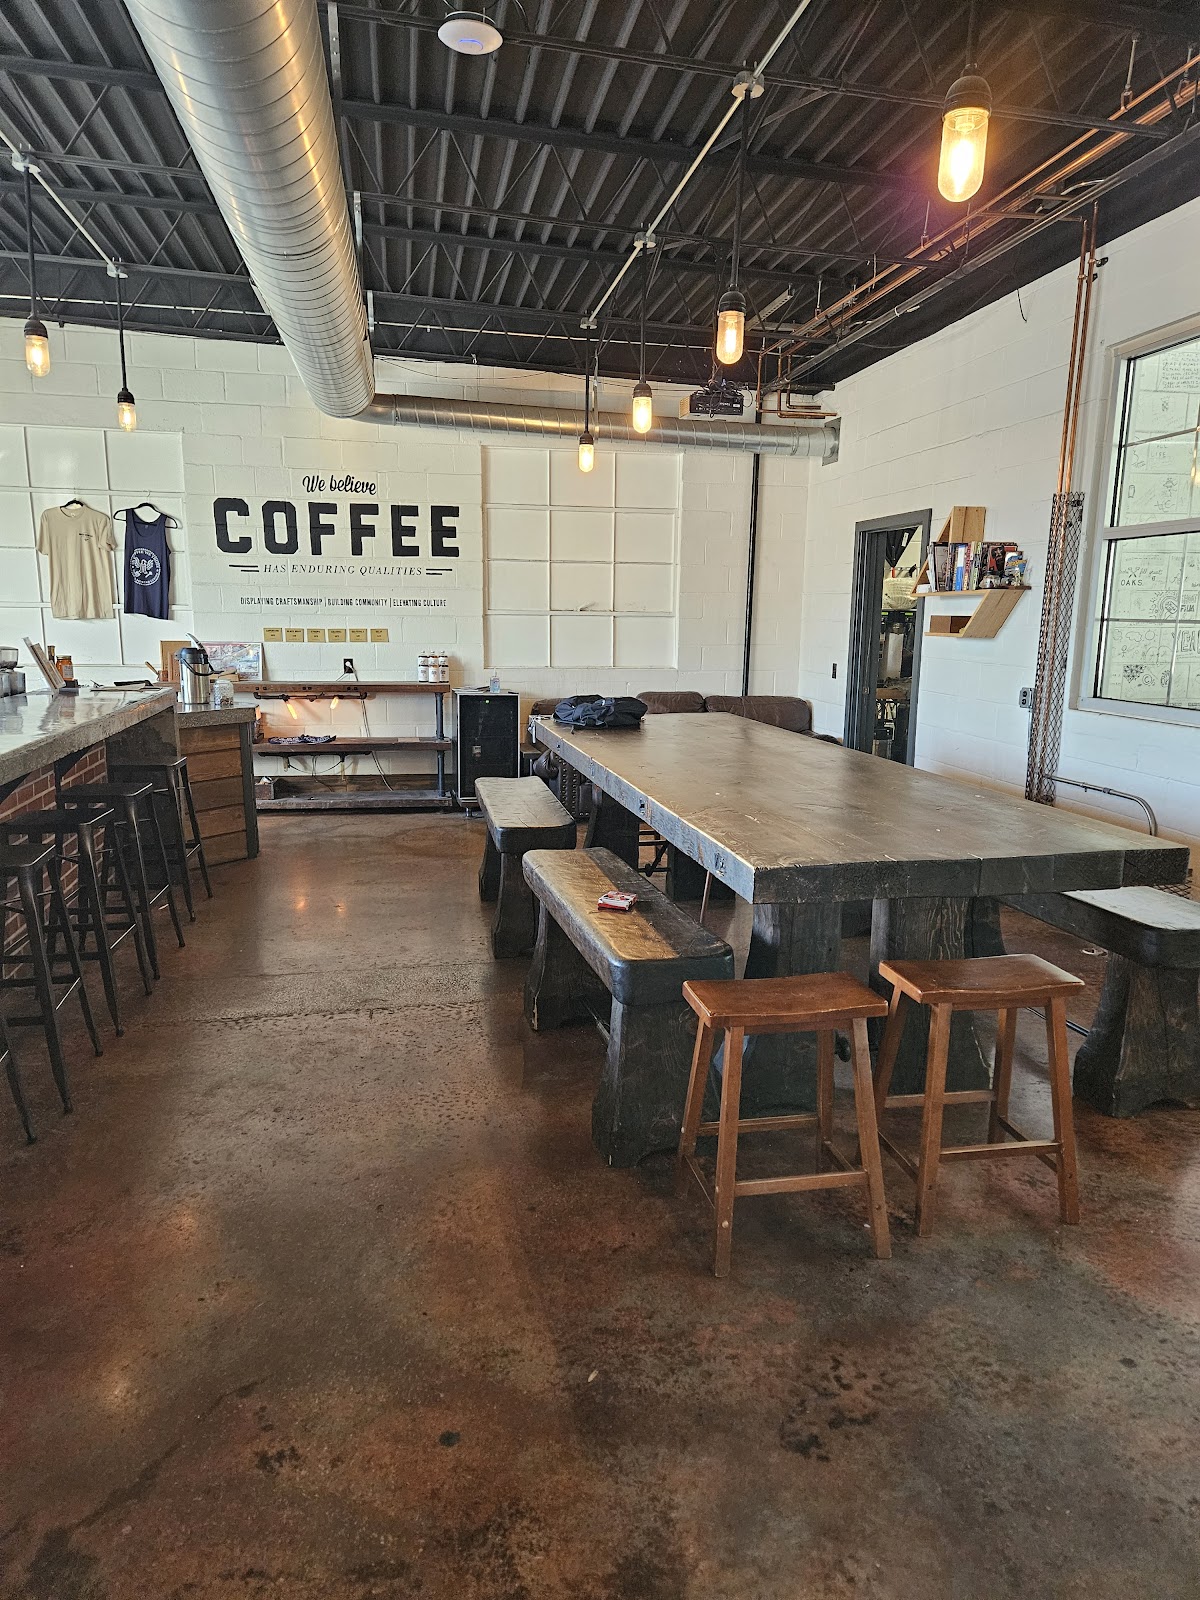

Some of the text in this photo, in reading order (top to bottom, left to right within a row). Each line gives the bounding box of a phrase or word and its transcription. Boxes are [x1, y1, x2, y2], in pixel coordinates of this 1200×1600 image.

[302, 474, 377, 496] We believe
[213, 497, 460, 558] COFFEE
[263, 564, 422, 577] HAS ENDURING QUALITIES
[1120, 579, 1143, 587] OAKS
[240, 596, 323, 606] DISPLAYING CRAFTSMANSHIP
[327, 598, 388, 607] BUILDING COMMUNITY
[393, 598, 447, 607] ELEVATING CULTURE
[1171, 629, 1200, 654] YEA
